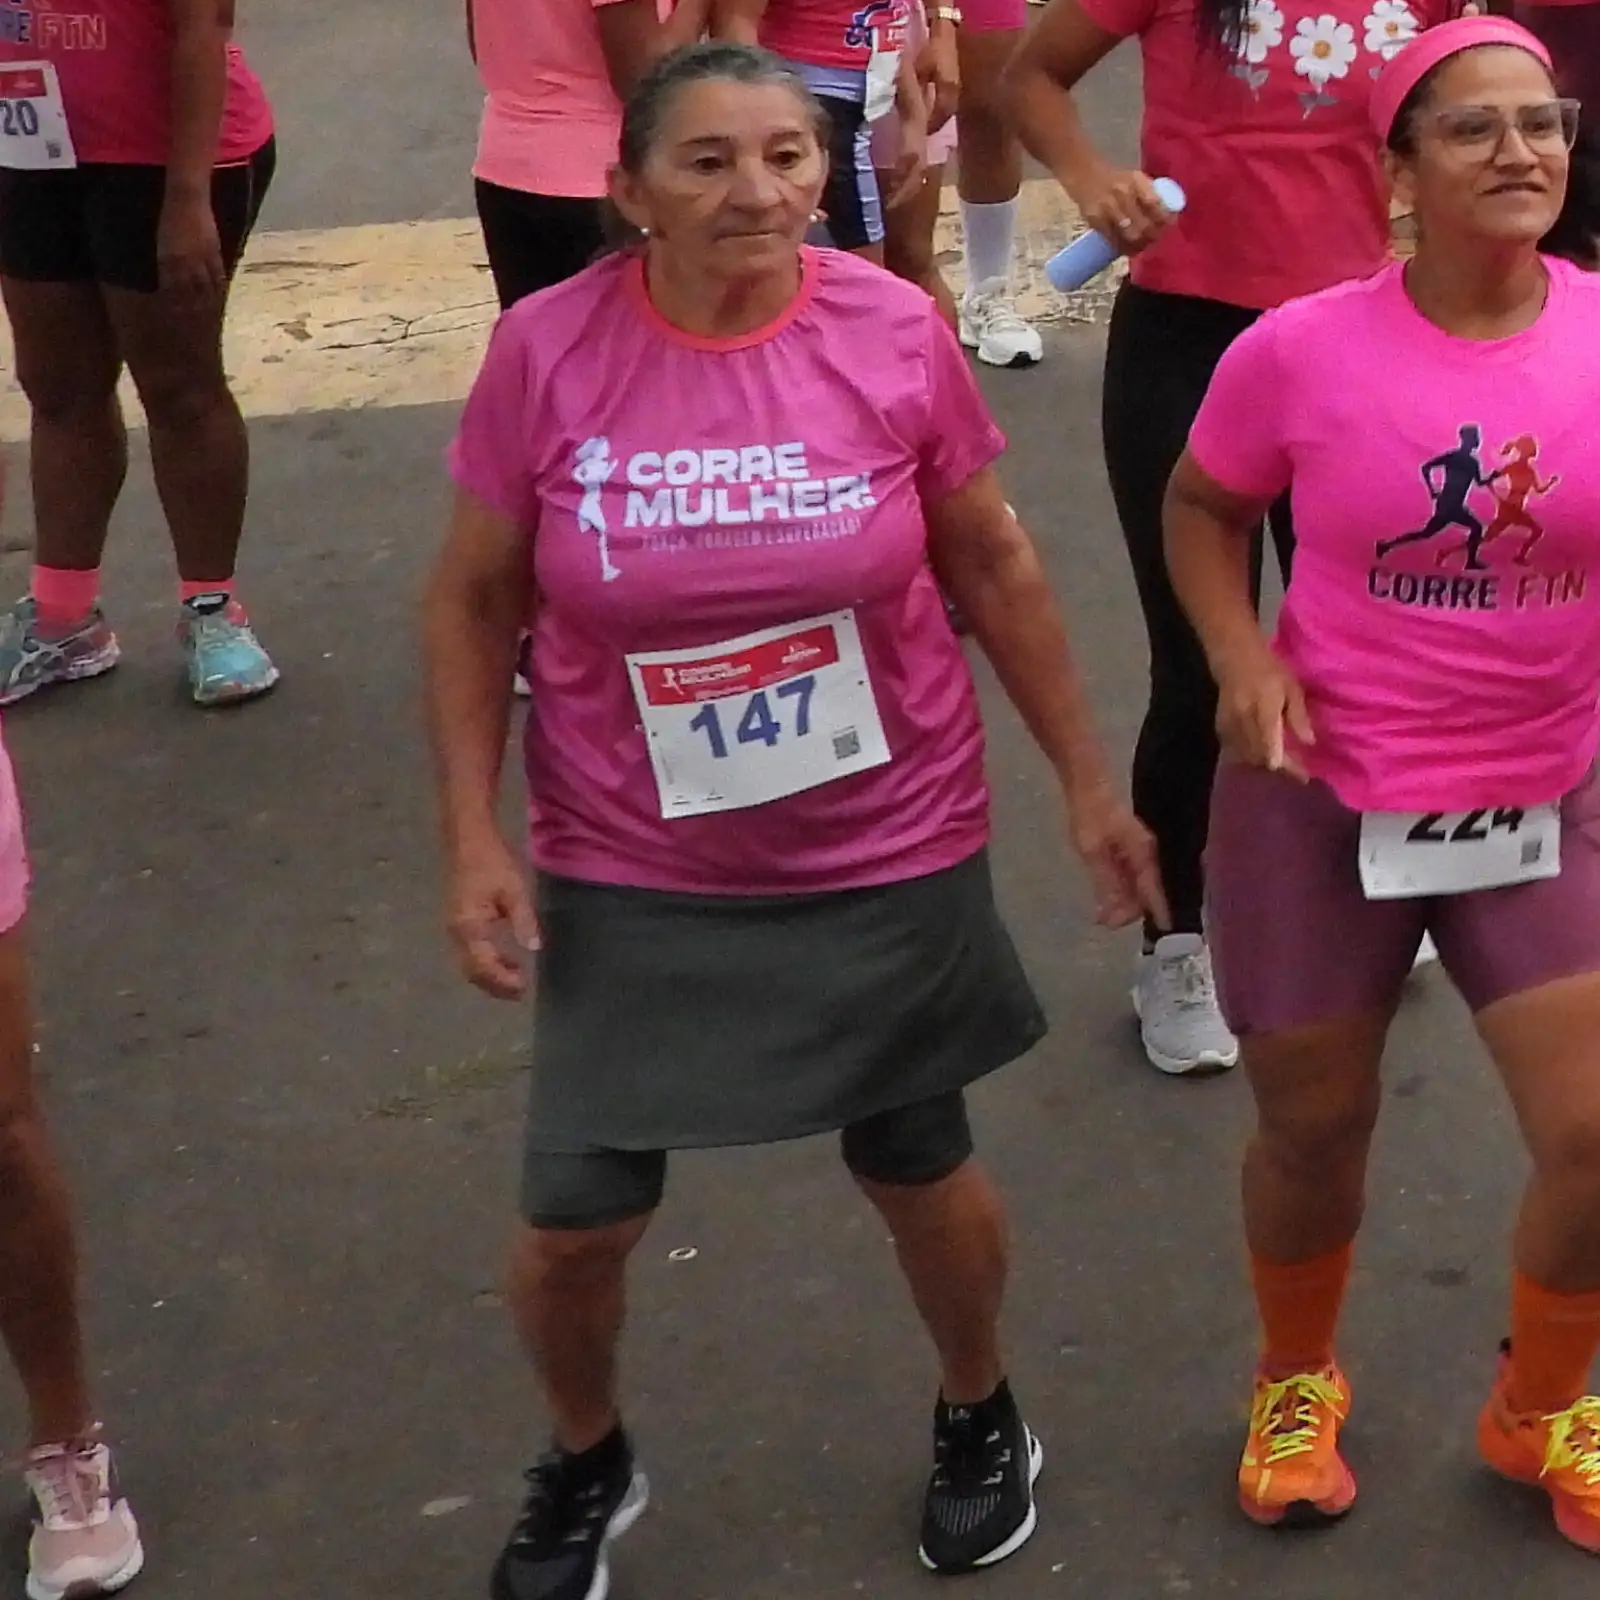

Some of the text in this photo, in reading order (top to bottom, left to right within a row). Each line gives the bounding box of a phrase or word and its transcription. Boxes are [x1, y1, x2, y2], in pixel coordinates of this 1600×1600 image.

[626, 442, 809, 485] CORRE
[624, 472, 878, 528] MULHER!
[1367, 566, 1589, 611] CORRE FTN
[690, 675, 817, 758] 147
